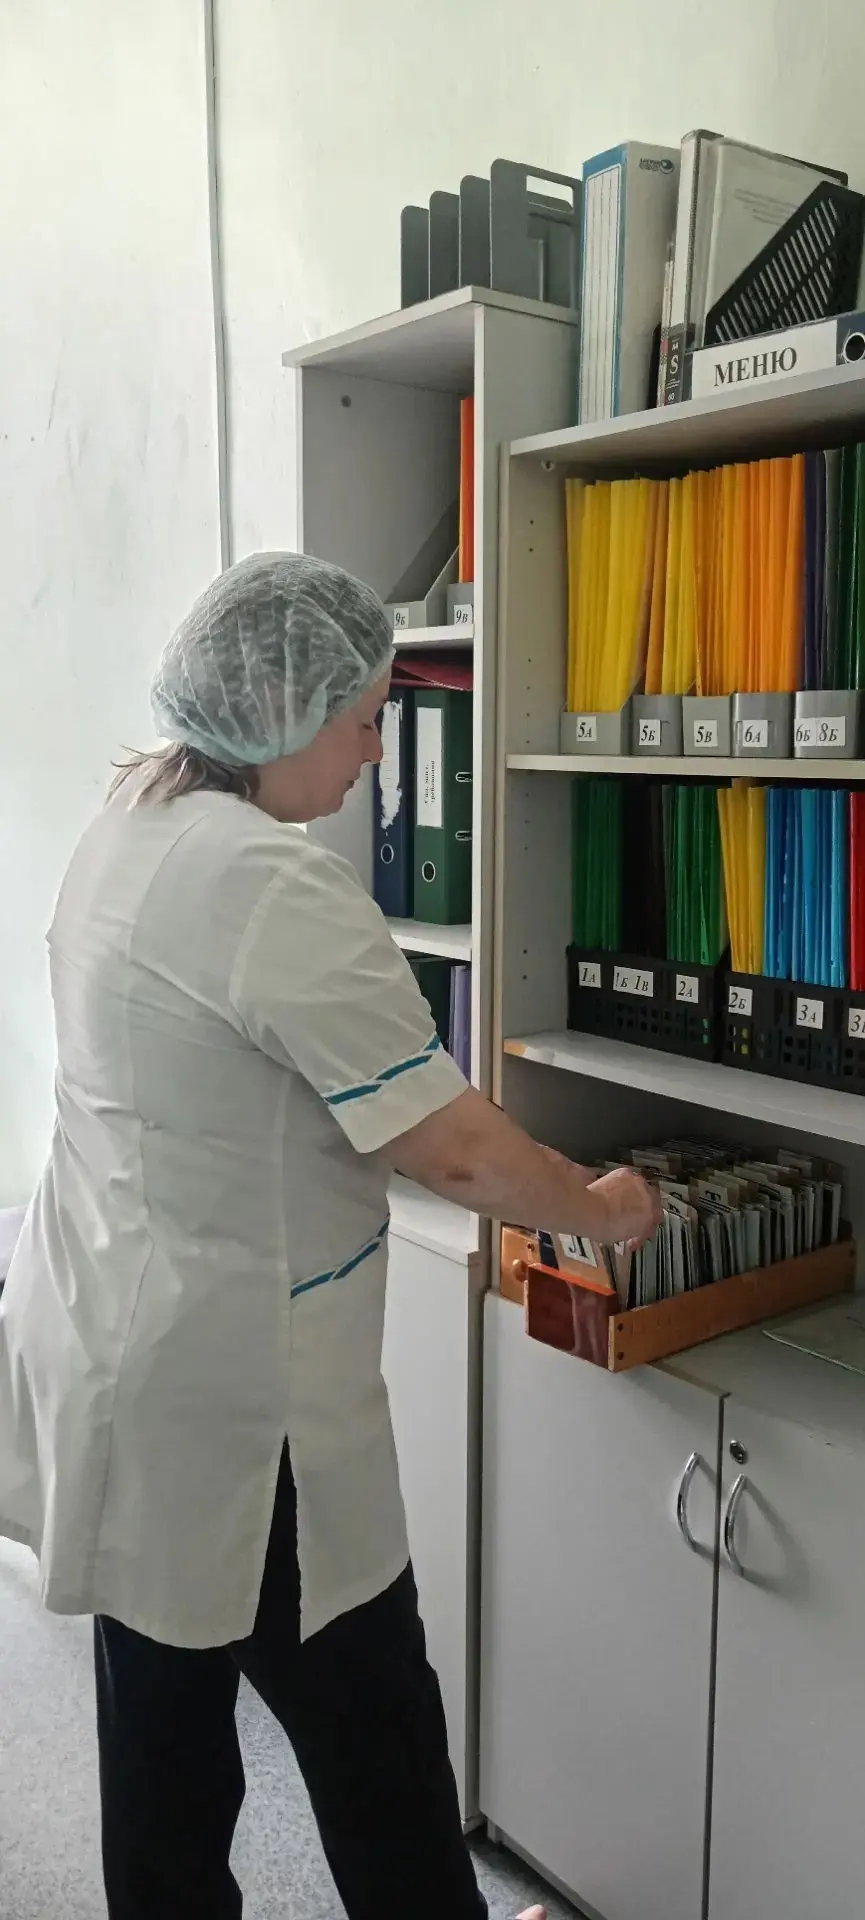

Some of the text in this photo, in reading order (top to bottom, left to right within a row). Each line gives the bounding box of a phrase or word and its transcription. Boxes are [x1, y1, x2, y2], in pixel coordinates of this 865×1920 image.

[714, 347, 797, 387] МЕНЮ
[456, 609, 469, 624] 9В
[578, 722, 592, 738] 5А
[641, 725, 656, 742] 5Б
[696, 726, 713, 743] 5В
[744, 725, 761, 743] 6А
[795, 722, 839, 742] 6Б 8Б
[582, 967, 596, 983] 1А
[634, 975, 649, 992] 1В
[678, 981, 693, 998] 2А
[728, 992, 747, 1010] 2Б
[797, 1004, 816, 1023] 3А
[850, 1014, 865, 1033] 3
